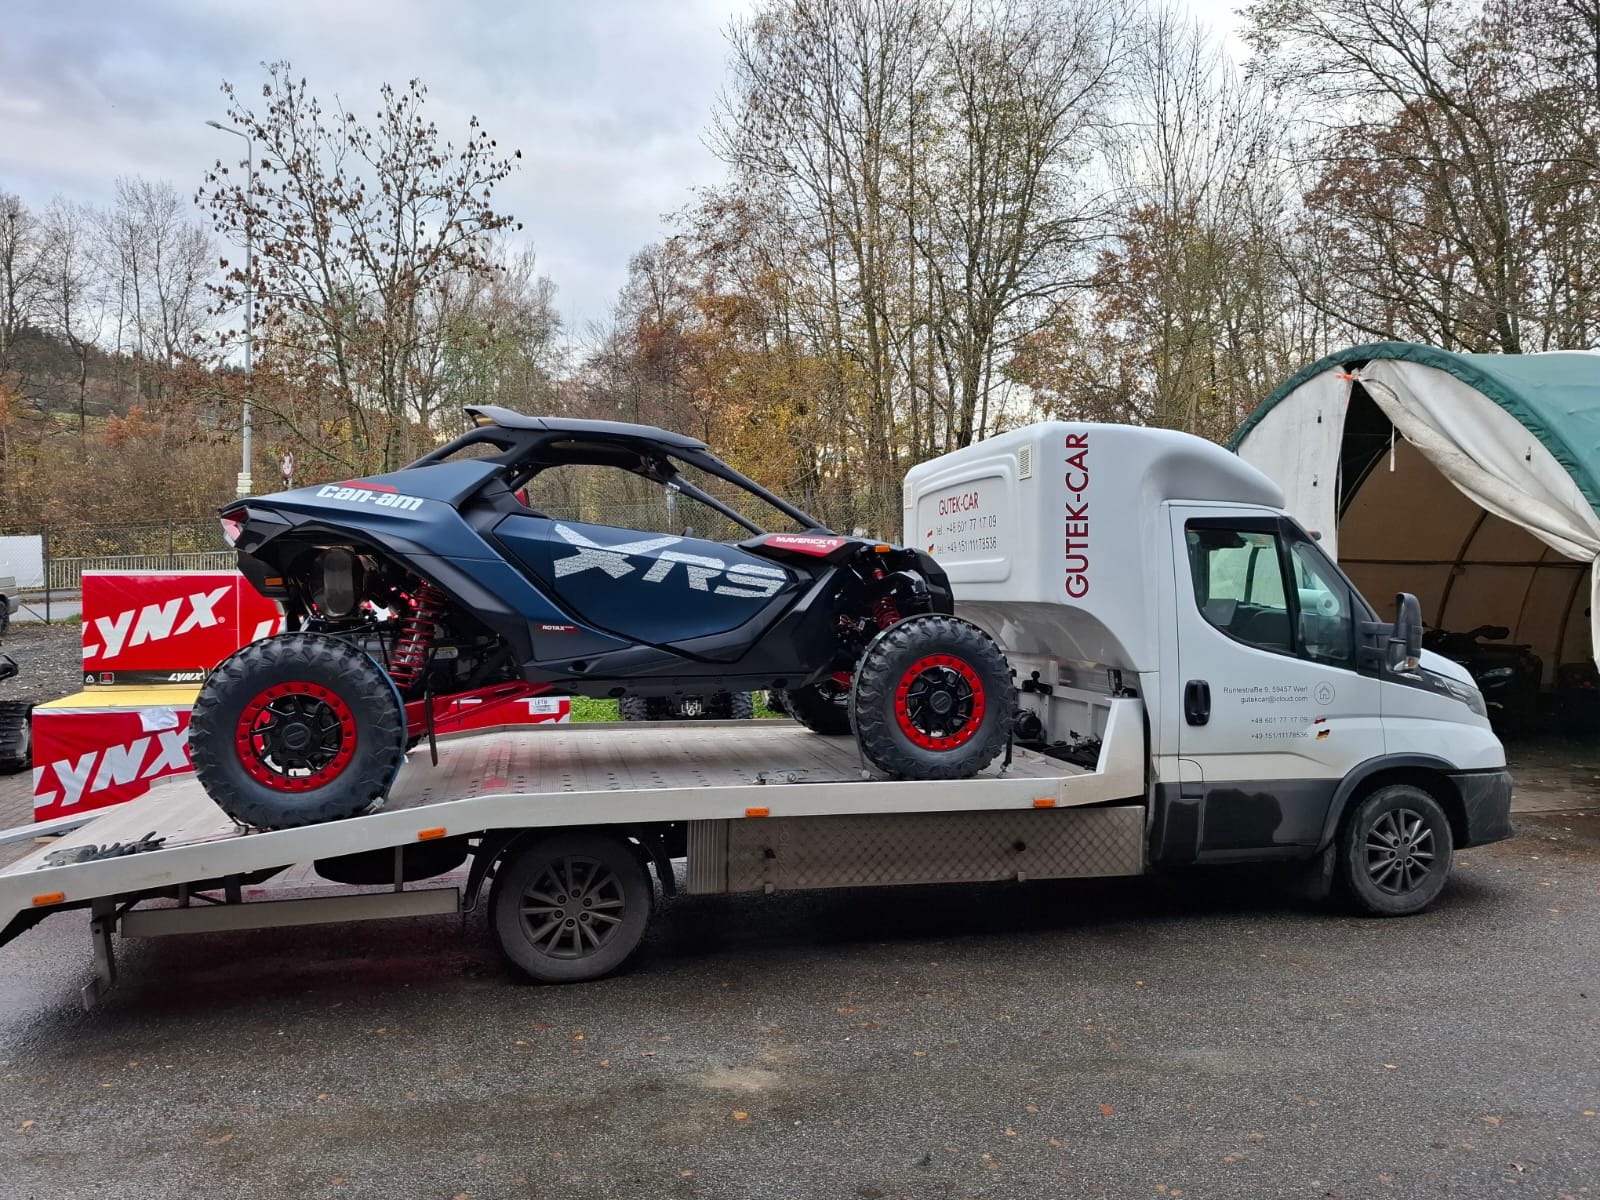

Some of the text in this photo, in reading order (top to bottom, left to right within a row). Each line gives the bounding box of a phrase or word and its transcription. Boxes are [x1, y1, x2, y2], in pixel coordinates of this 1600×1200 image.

[316, 485, 424, 511] can-am
[938, 491, 979, 516] GUTEK-CAR
[969, 518, 977, 531] 77
[988, 515, 997, 528] 09
[1065, 432, 1089, 599] GUTEK-CAR
[776, 536, 826, 546] MAVERICK
[553, 523, 788, 598] XRS
[168, 672, 205, 682] LYNX
